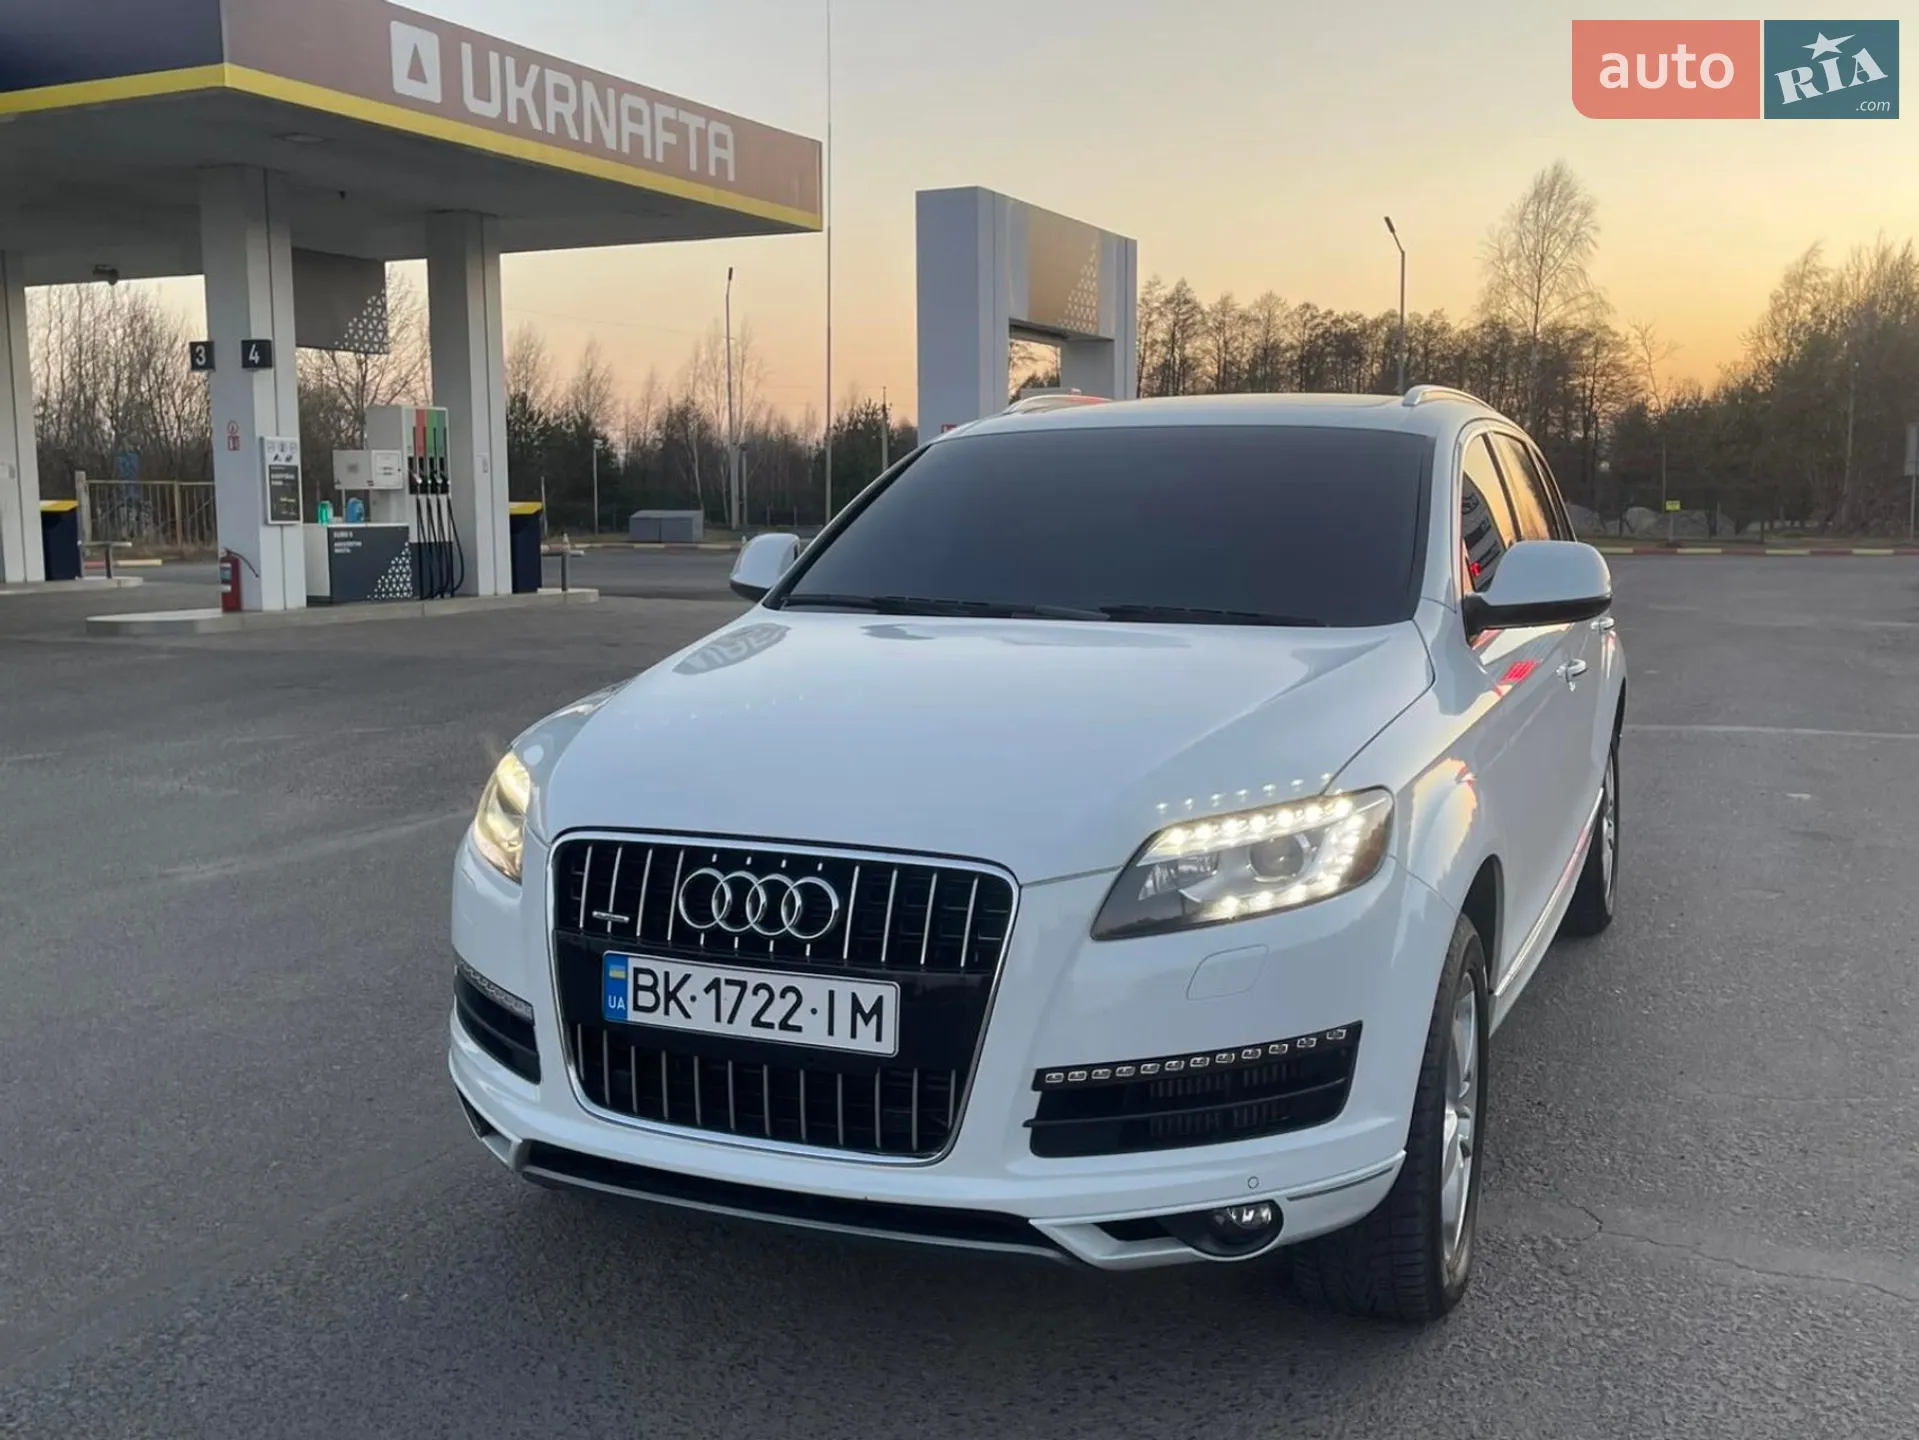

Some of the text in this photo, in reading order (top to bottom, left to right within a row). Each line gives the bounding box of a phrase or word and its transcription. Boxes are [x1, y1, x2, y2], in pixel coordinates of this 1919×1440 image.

[460, 41, 735, 182] UKRNAFTA
[195, 344, 207, 366] 3
[248, 343, 260, 365] 4
[608, 994, 626, 1011] UA
